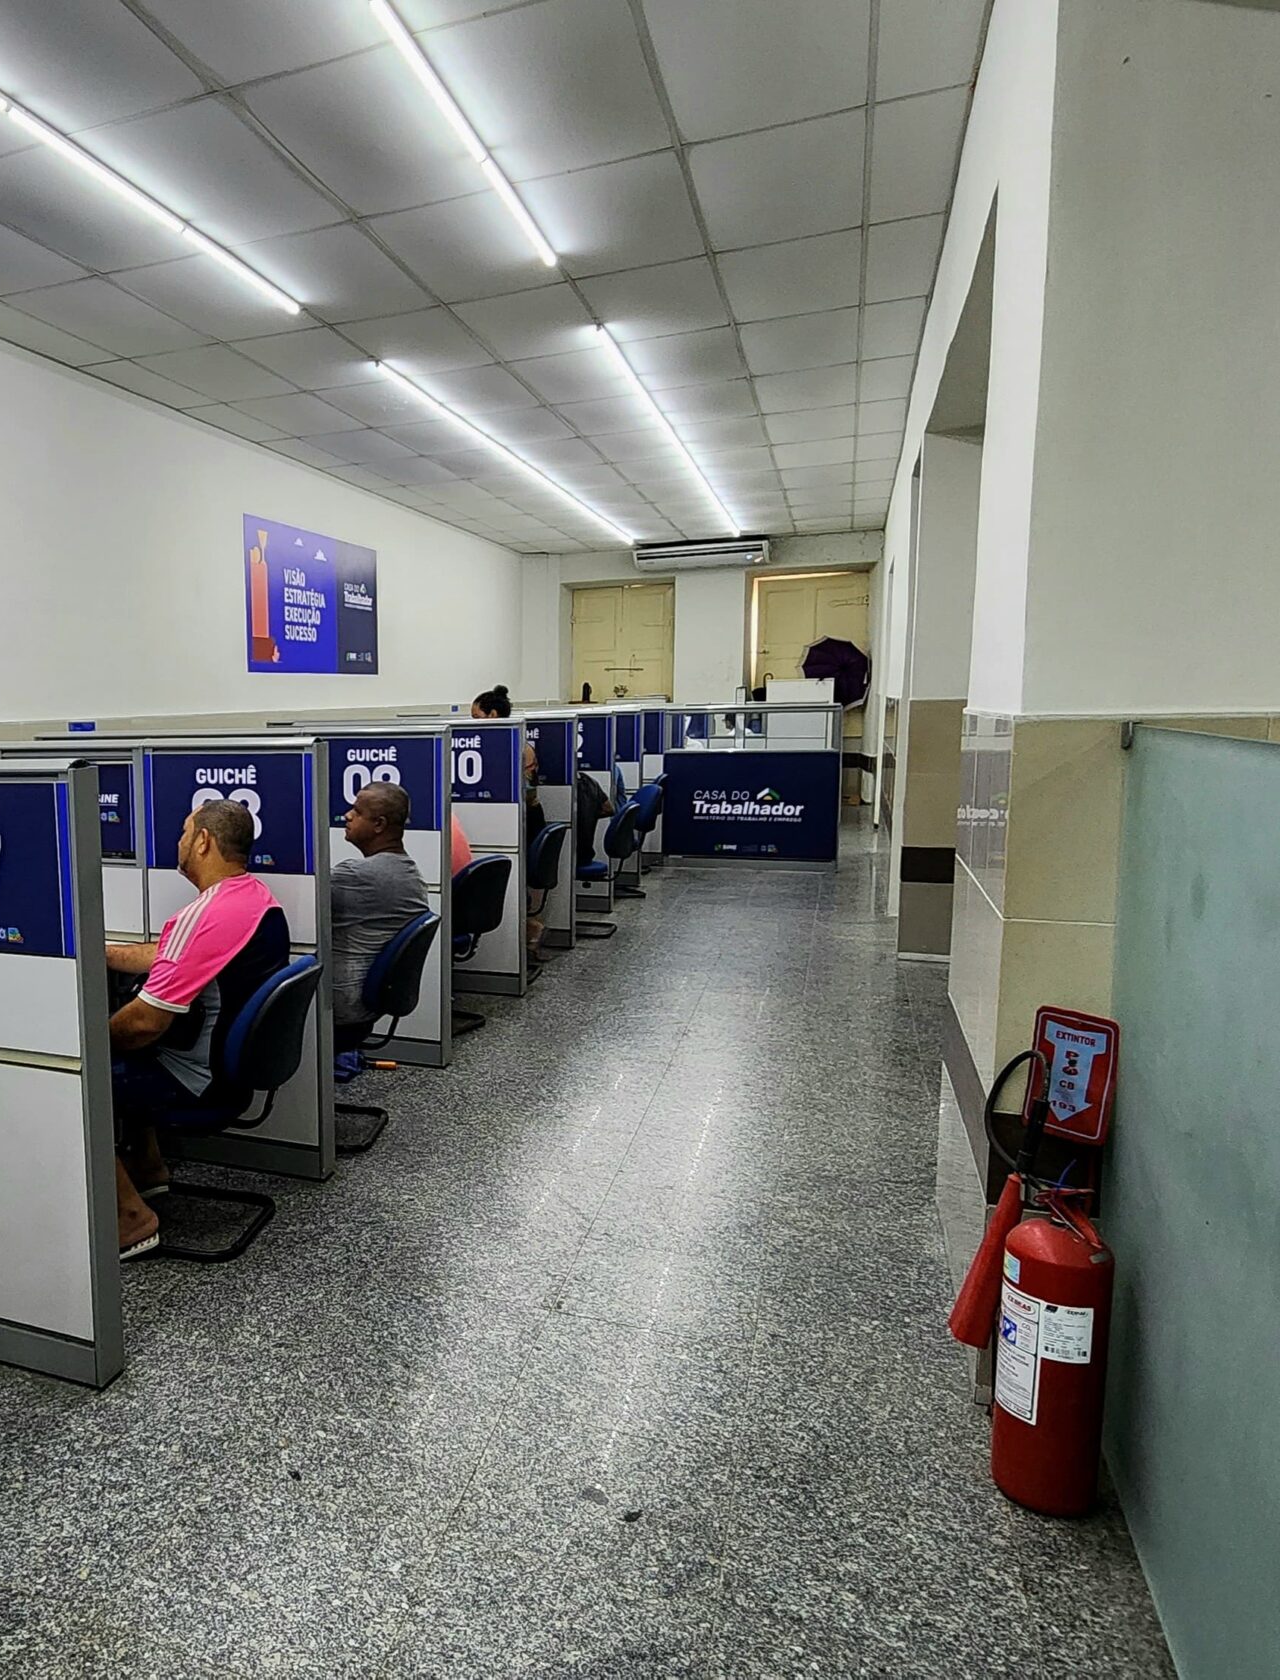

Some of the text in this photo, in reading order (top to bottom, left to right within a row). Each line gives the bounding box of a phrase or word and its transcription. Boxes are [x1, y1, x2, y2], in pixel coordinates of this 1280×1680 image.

[284, 568, 306, 588] VISÃO
[284, 587, 326, 609] ESTRATÉGIA
[284, 606, 321, 627] EXECUÇÃO
[285, 624, 317, 642] SUCESSO
[347, 746, 397, 762] GUICHÊ
[195, 764, 257, 785] GUICHÊ
[693, 790, 750, 800] CASA DO
[692, 800, 805, 816] Trabalhador
[1055, 1030, 1096, 1047] EXTINTOR
